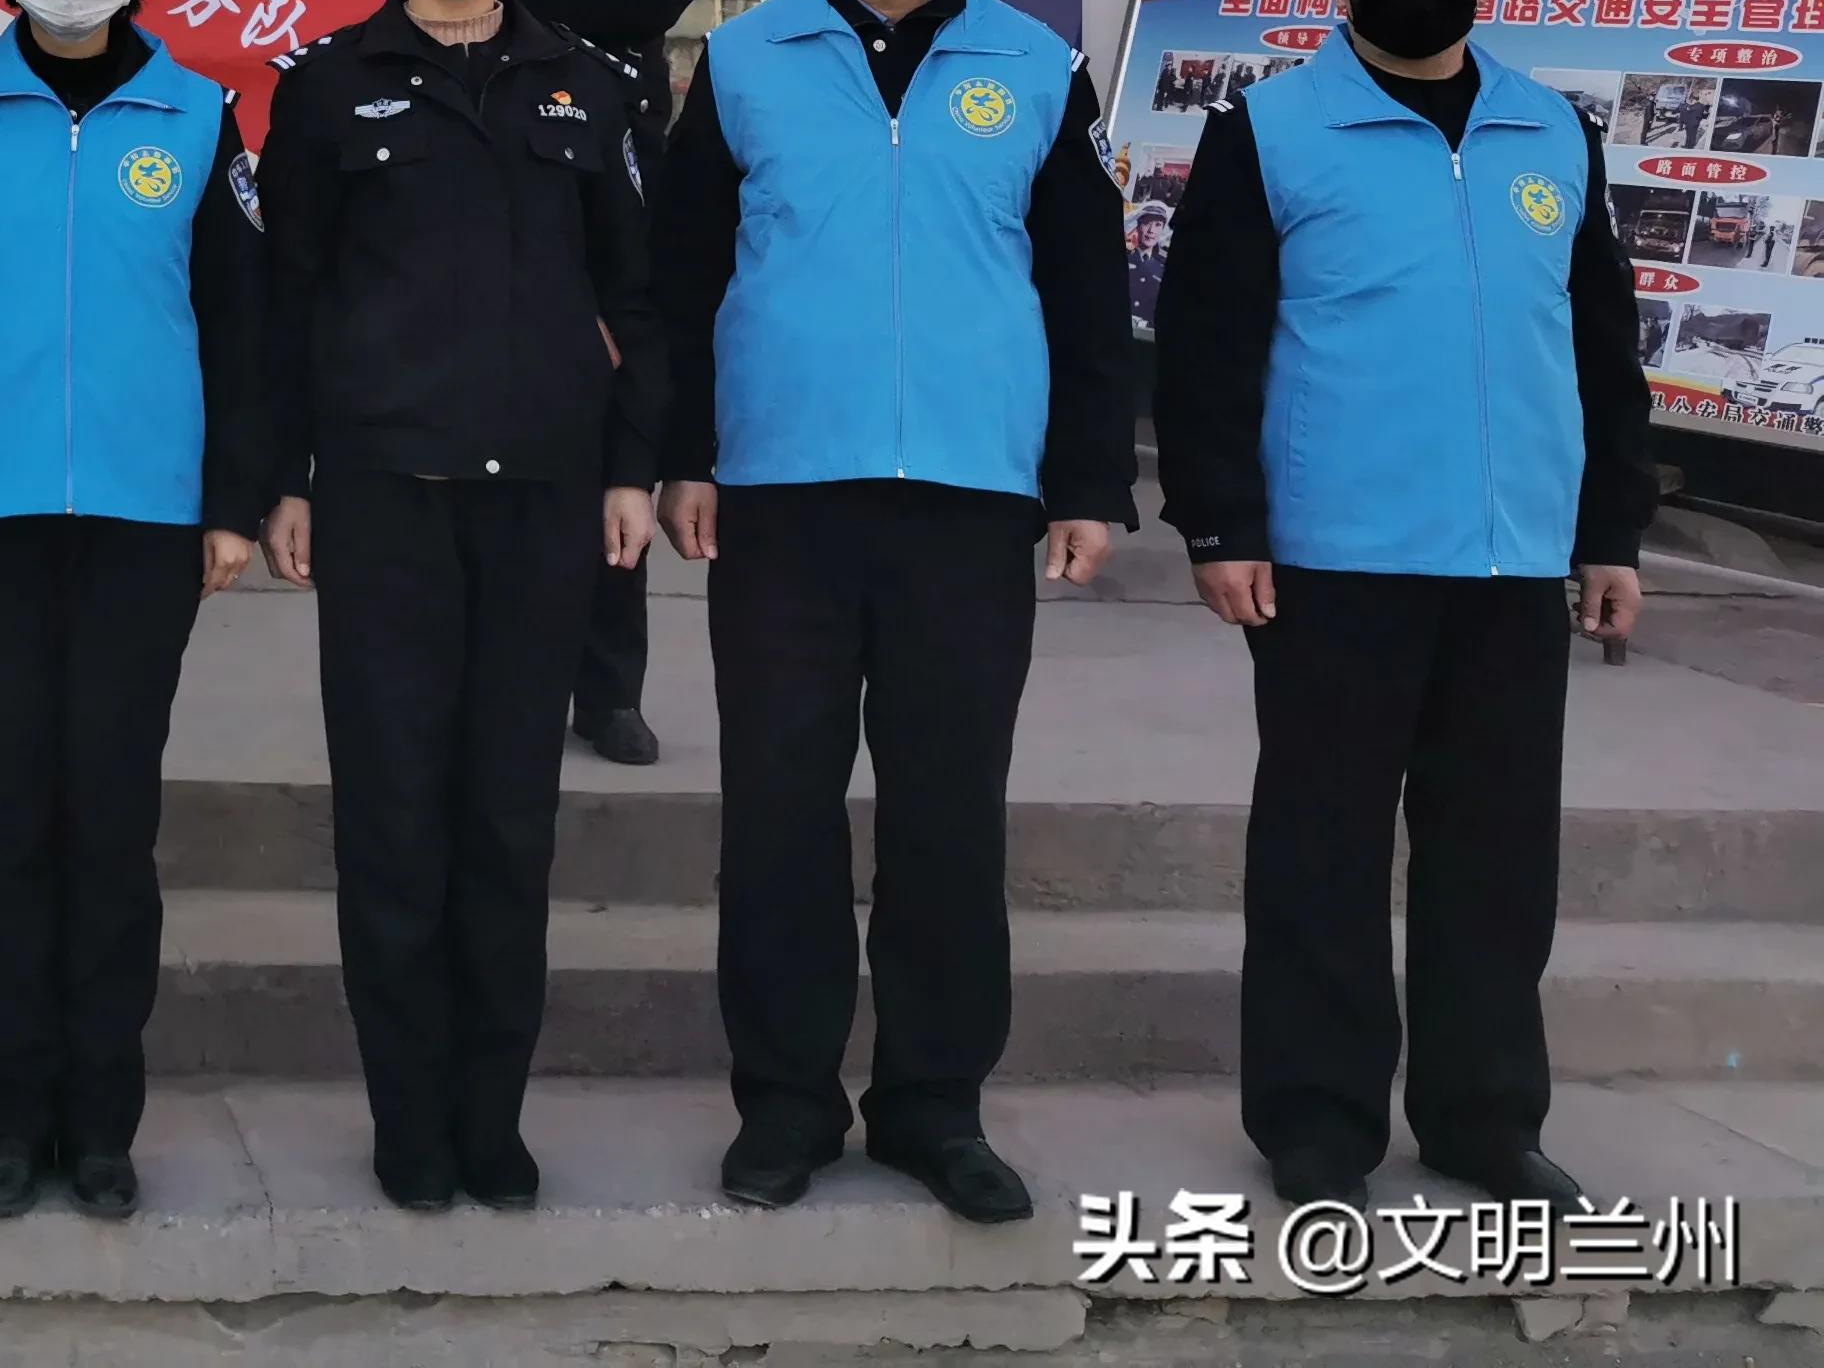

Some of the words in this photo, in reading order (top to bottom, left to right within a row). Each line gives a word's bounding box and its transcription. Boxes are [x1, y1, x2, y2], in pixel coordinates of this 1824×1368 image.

[1686, 45, 1778, 67] 专项整治
[538, 104, 587, 121] 129020
[1655, 159, 1748, 181] 路面管控
[1639, 271, 1679, 290] 群众
[1191, 536, 1221, 548] POLICE
